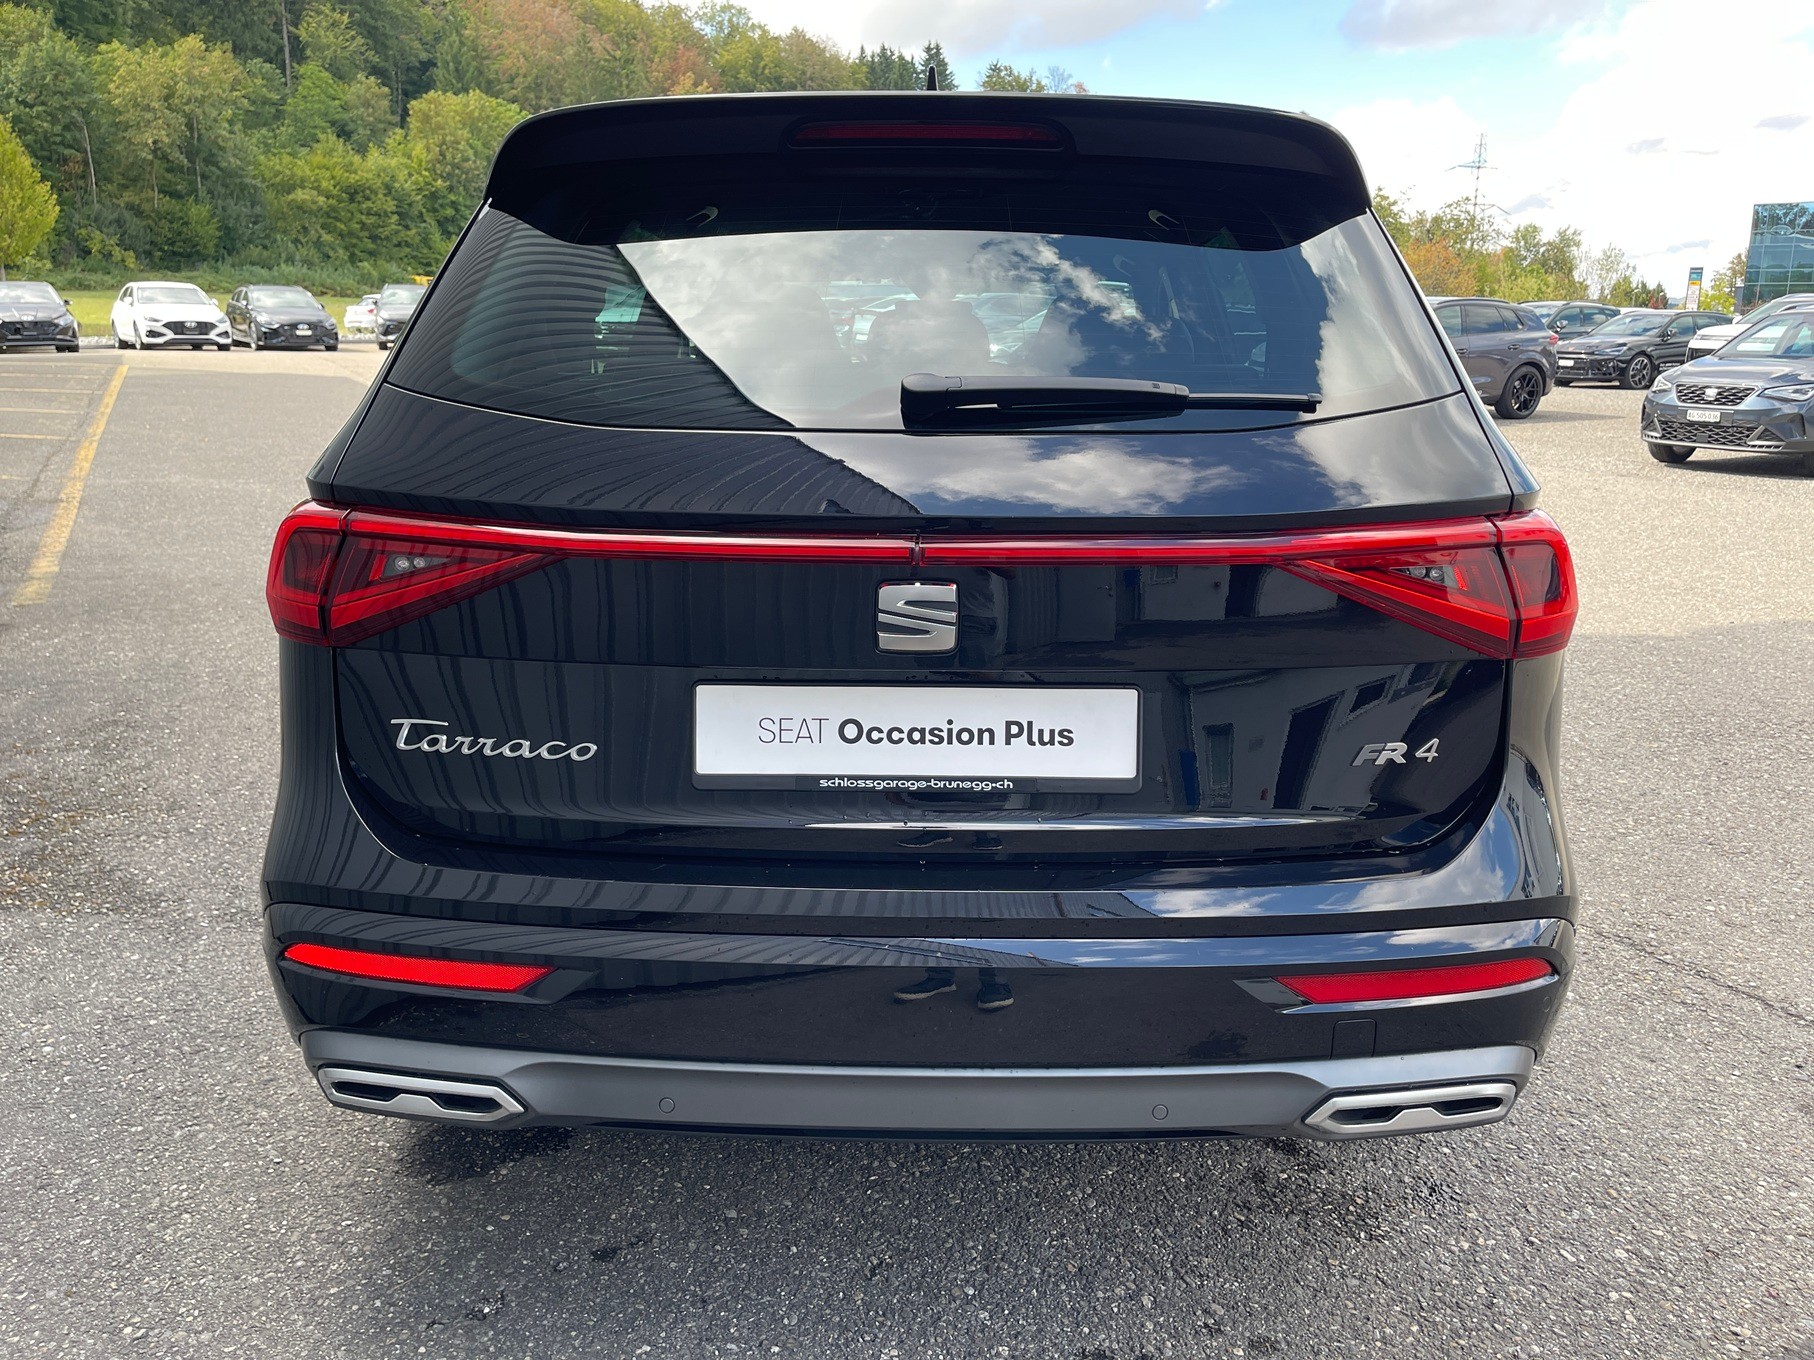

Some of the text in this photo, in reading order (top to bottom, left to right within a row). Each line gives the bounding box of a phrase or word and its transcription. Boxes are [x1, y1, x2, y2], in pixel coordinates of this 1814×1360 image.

[390, 718, 598, 762] Tarraco
[758, 717, 1075, 747] SEAT Occasion Plus
[1351, 738, 1440, 766] FR 4
